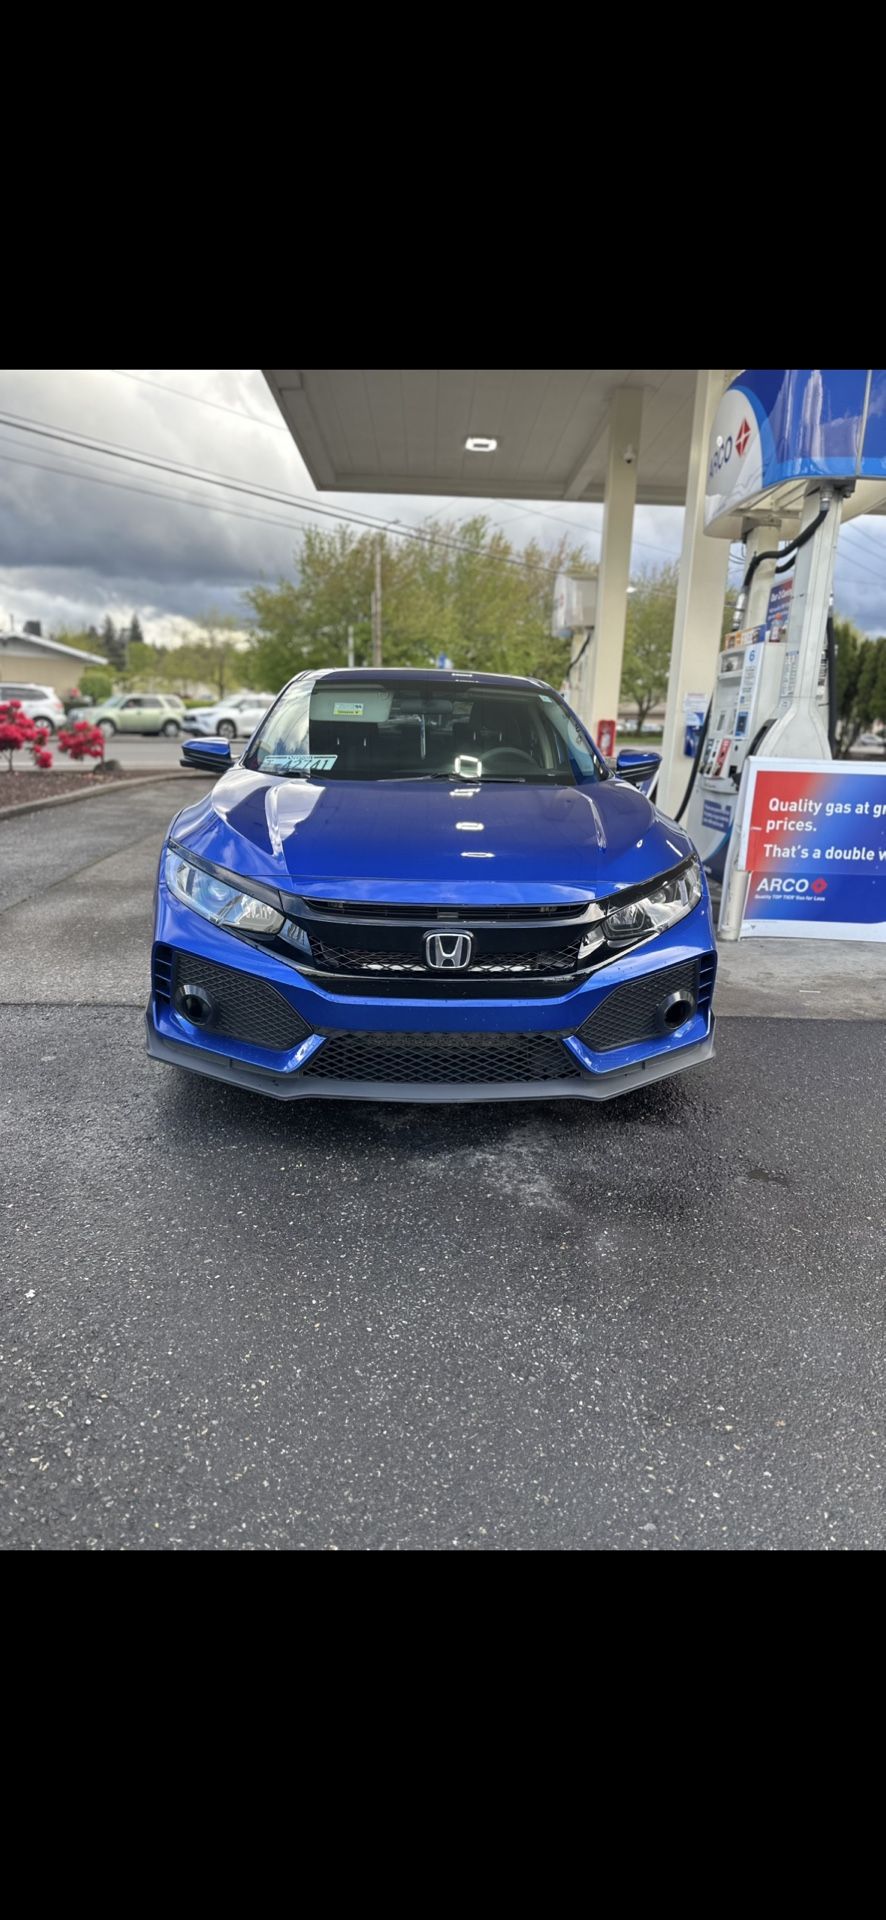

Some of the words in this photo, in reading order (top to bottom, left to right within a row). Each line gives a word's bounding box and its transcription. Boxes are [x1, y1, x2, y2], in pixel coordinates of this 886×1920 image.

[768, 797, 822, 816] Quality
[825, 802, 852, 816] gas
[855, 801, 870, 815] at
[766, 817, 817, 833] prices.
[763, 844, 809, 859] That's
[812, 848, 822, 859] a
[825, 846, 875, 861] double
[756, 878, 809, 893] ARCO
